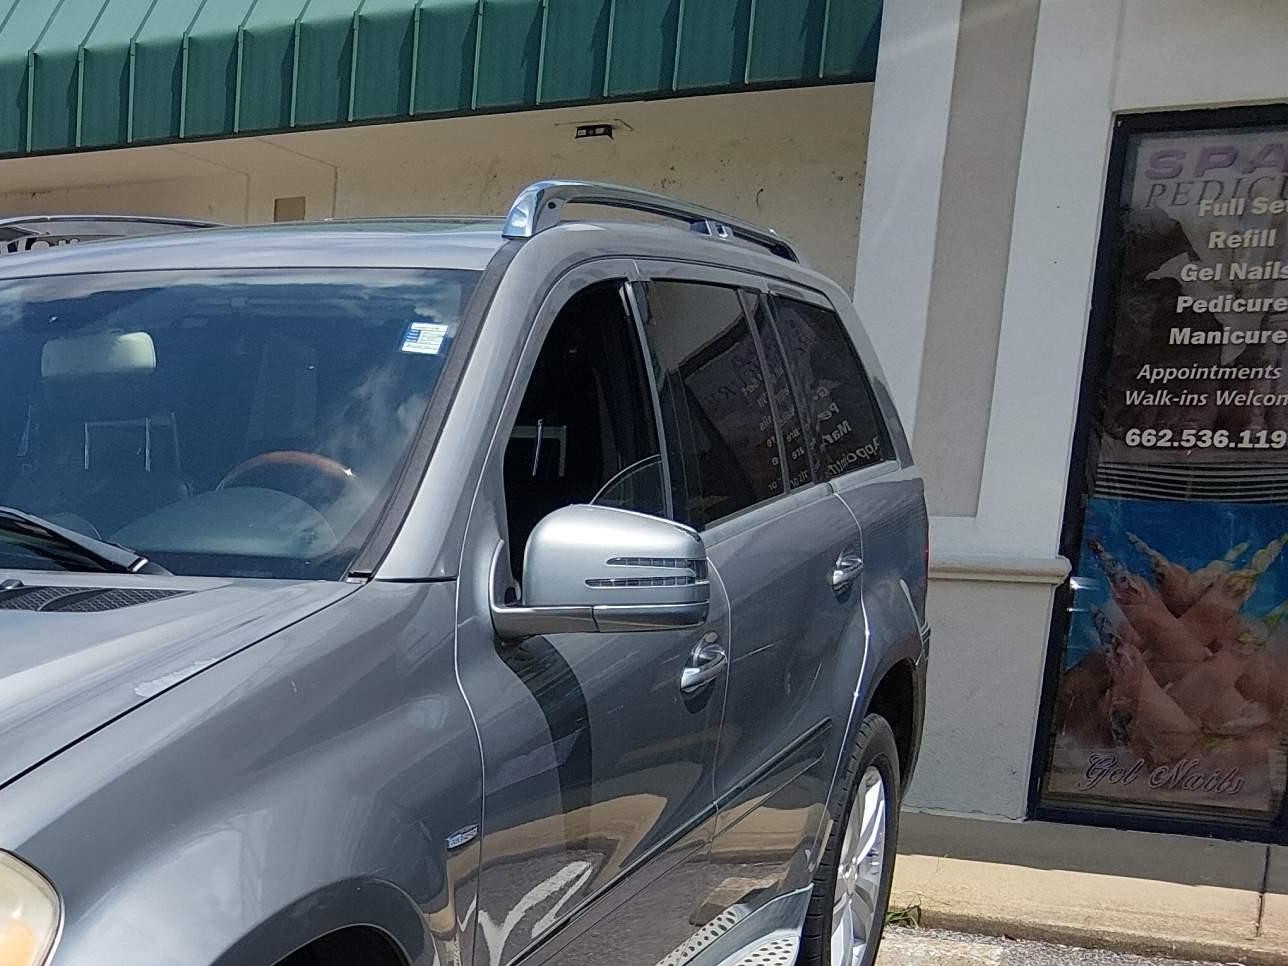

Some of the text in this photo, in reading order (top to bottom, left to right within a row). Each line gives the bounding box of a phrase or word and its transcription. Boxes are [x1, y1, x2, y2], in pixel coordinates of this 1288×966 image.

[1145, 143, 1288, 180] SPA
[1198, 198, 1246, 217] Full
[1208, 229, 1277, 249] Refill
[1180, 261, 1288, 282] Gel Nails
[1136, 364, 1282, 384] Appointments
[1125, 390, 1208, 406] Walk-ins
[1078, 753, 1245, 794] Gel Nails
